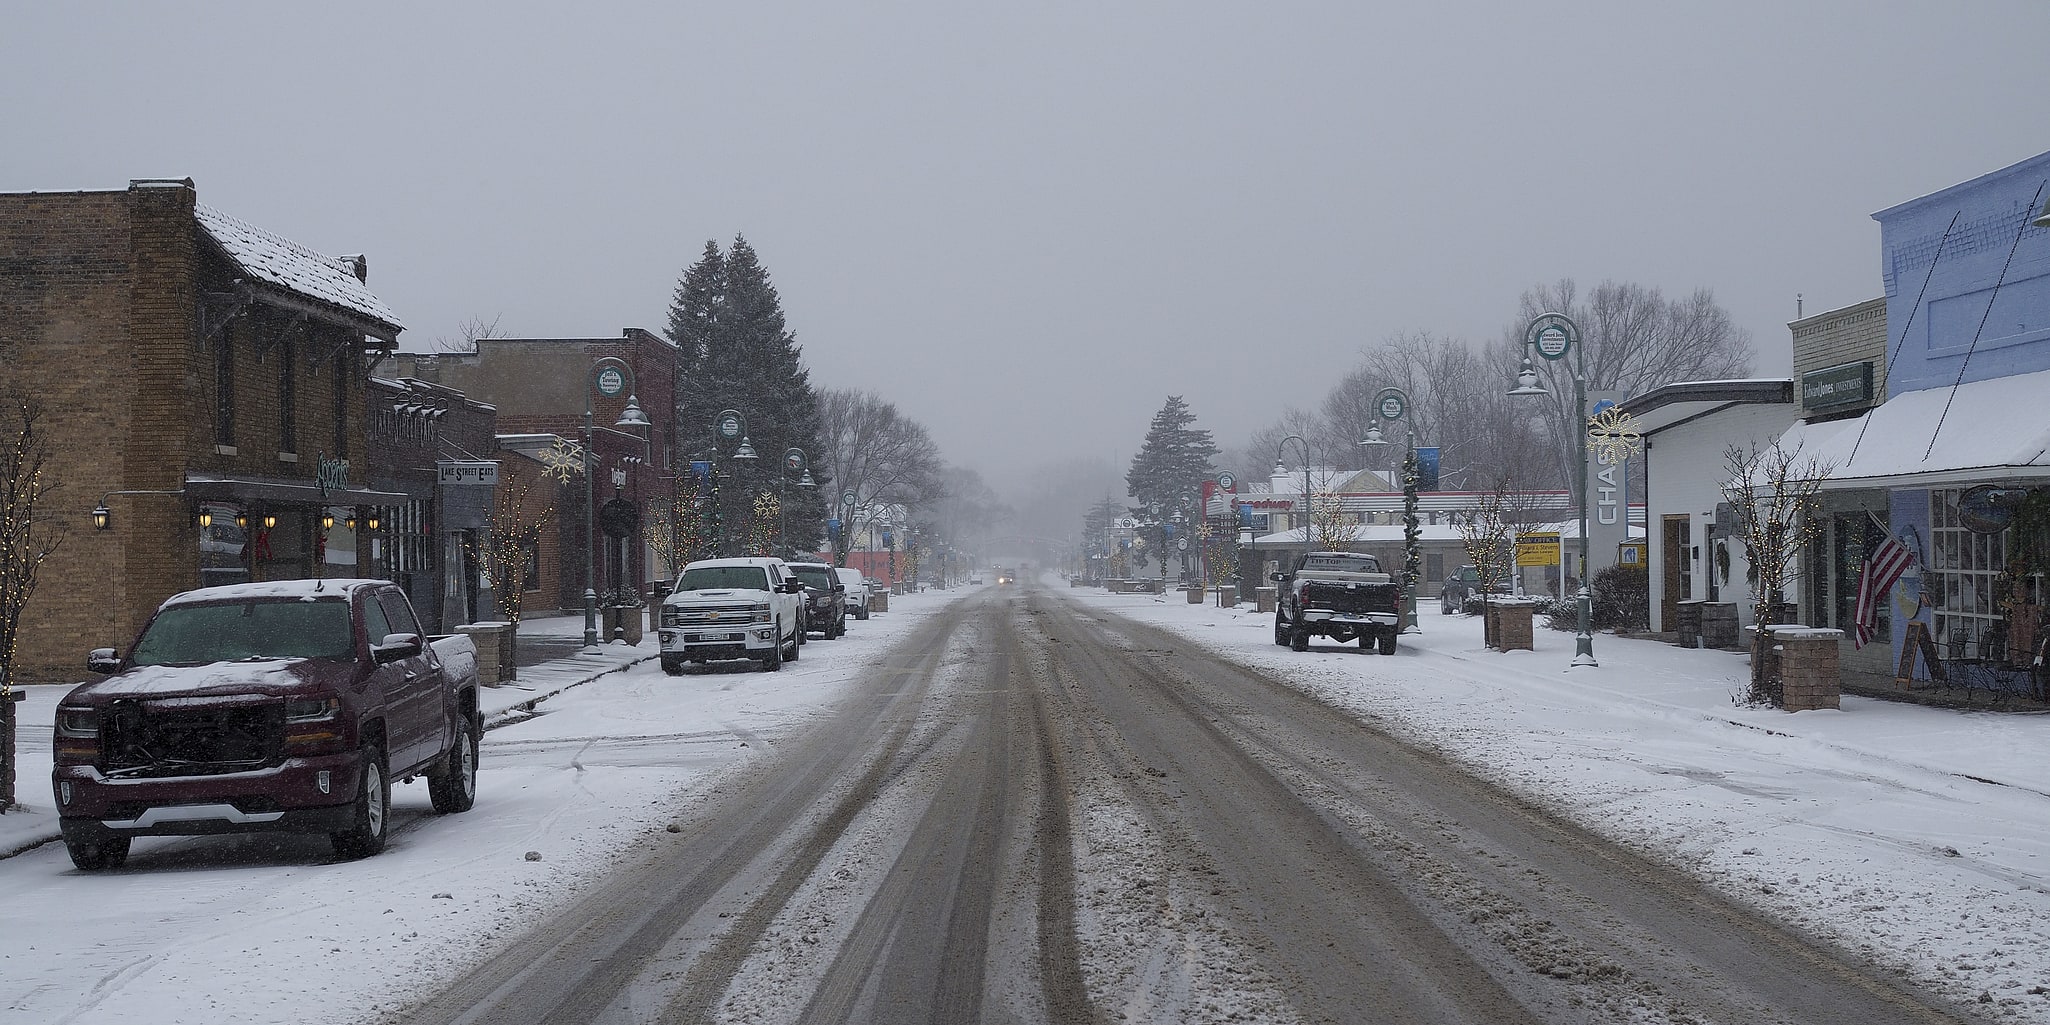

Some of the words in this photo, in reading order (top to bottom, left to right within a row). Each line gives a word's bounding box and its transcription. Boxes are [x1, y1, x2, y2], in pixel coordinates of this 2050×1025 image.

[420, 417, 435, 448] EATS
[440, 467, 455, 481] LAKE
[456, 467, 477, 482] STREET
[479, 467, 494, 481] EATS
[1326, 558, 1341, 566] TOP
